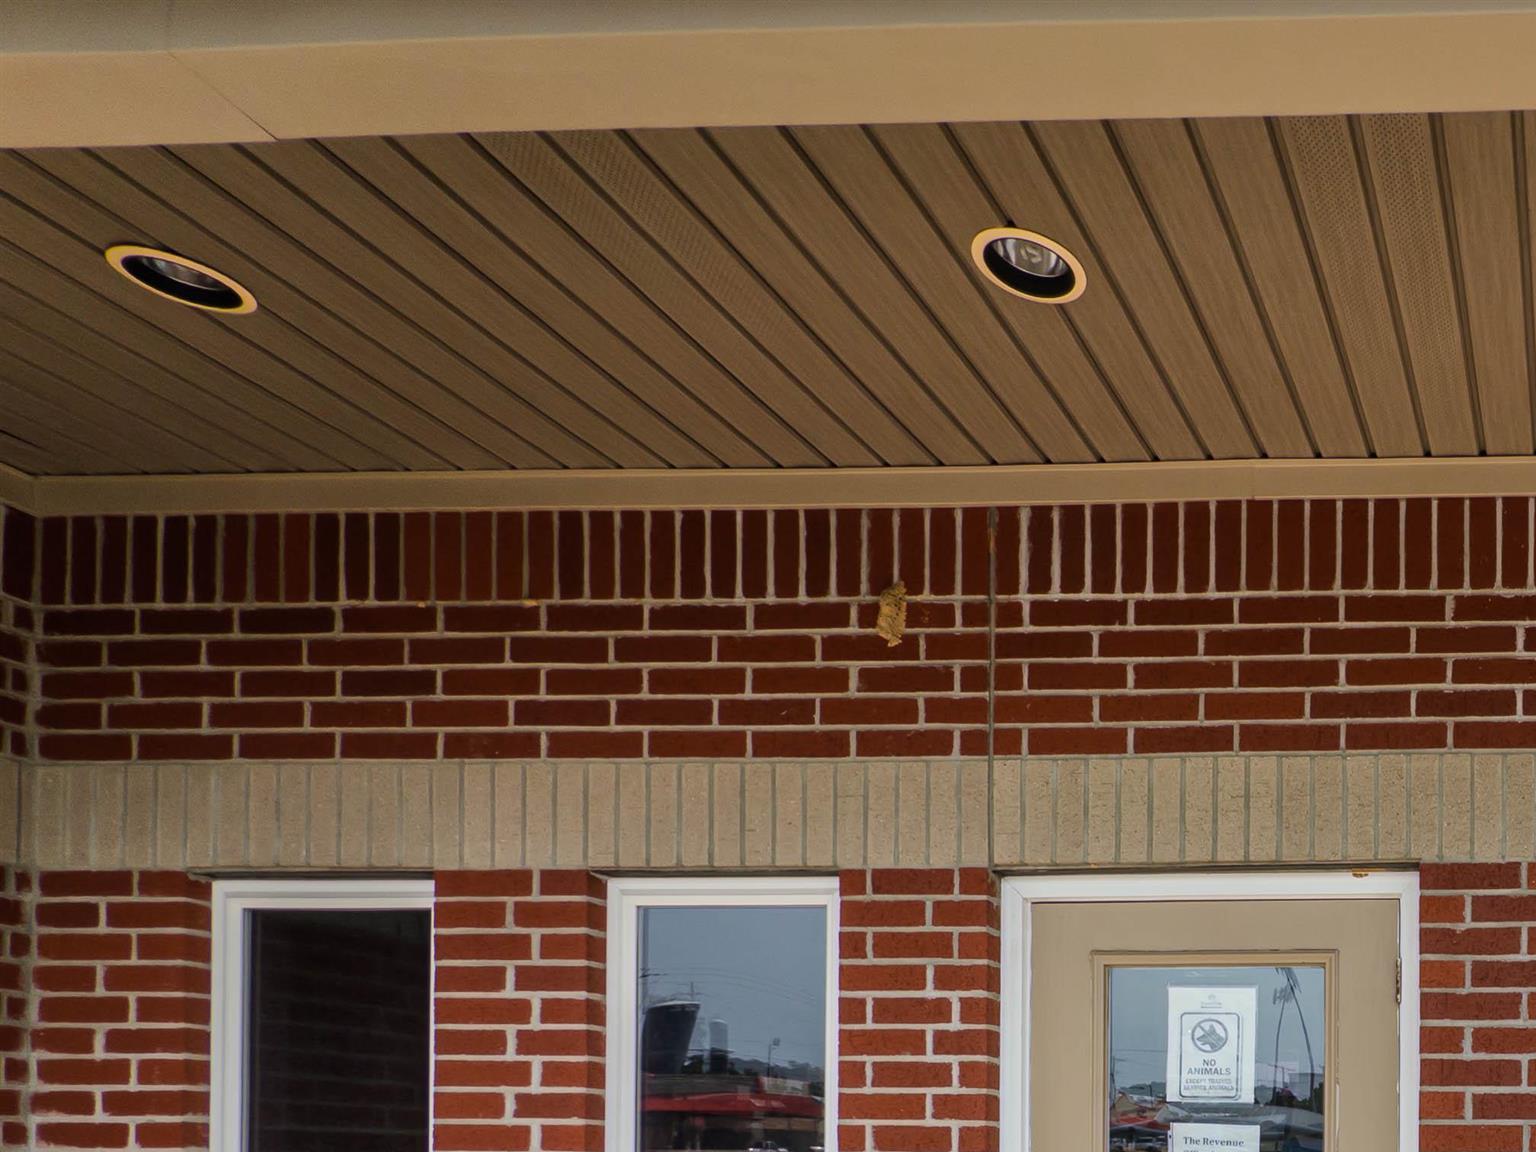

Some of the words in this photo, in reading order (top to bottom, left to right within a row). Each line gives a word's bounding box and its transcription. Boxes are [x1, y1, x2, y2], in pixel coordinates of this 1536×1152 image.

[1203, 1059, 1216, 1067] NO
[1187, 1067, 1231, 1075] ANIMALS
[1183, 1137, 1200, 1145] The
[1202, 1138, 1245, 1147] Revenue
